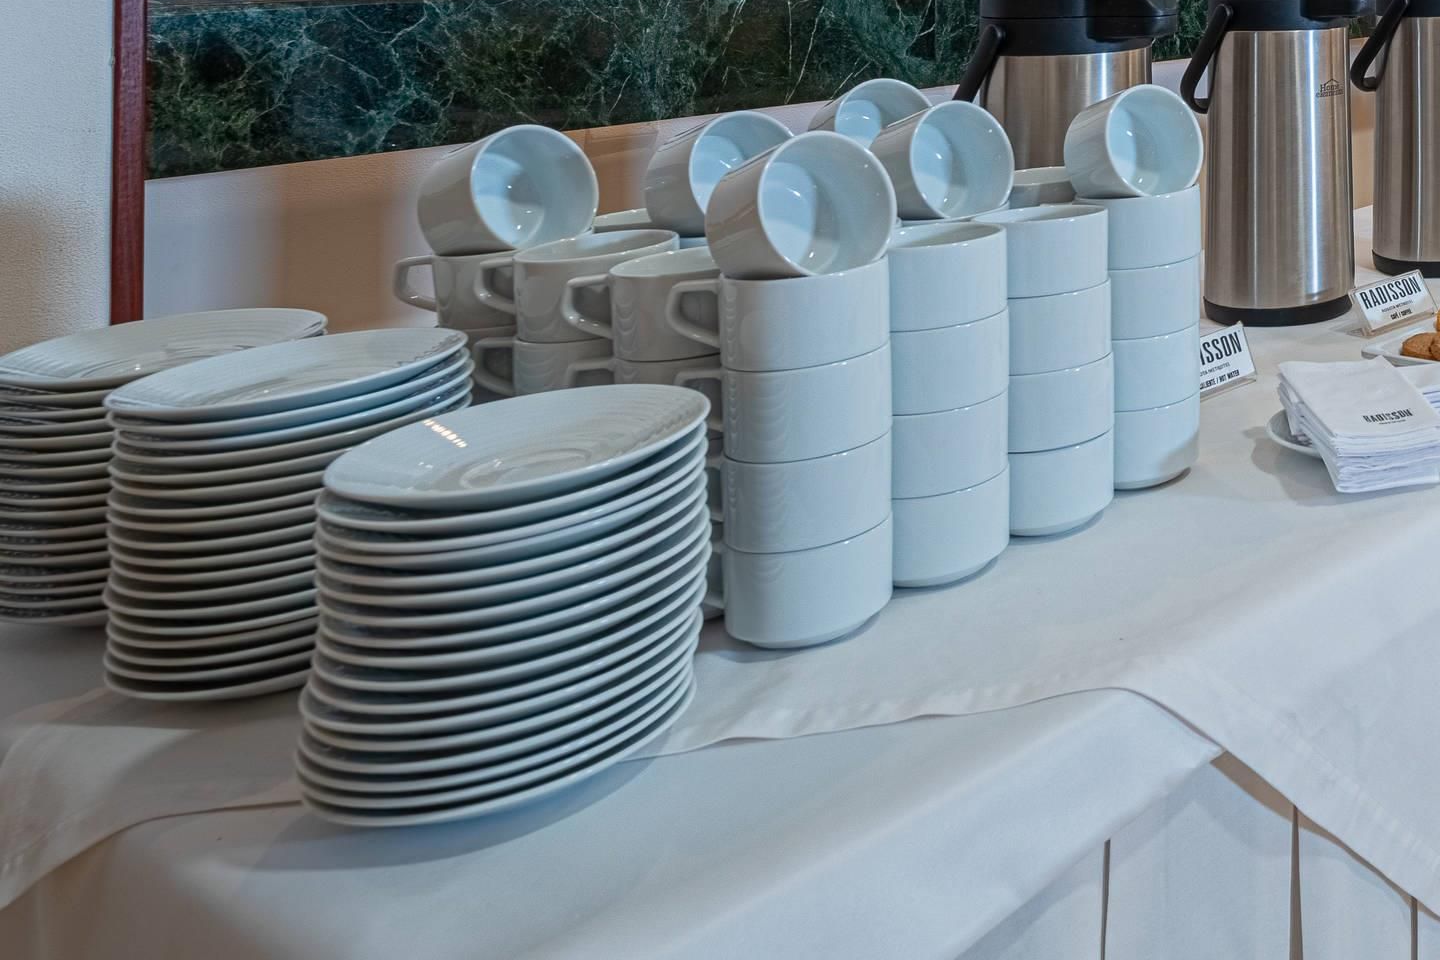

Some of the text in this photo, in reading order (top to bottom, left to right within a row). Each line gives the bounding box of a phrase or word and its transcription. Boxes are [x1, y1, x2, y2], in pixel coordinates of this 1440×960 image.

[1360, 276, 1422, 310] RADISSON
[1200, 331, 1243, 366] ISSON
[1362, 408, 1414, 423] RADISSON
